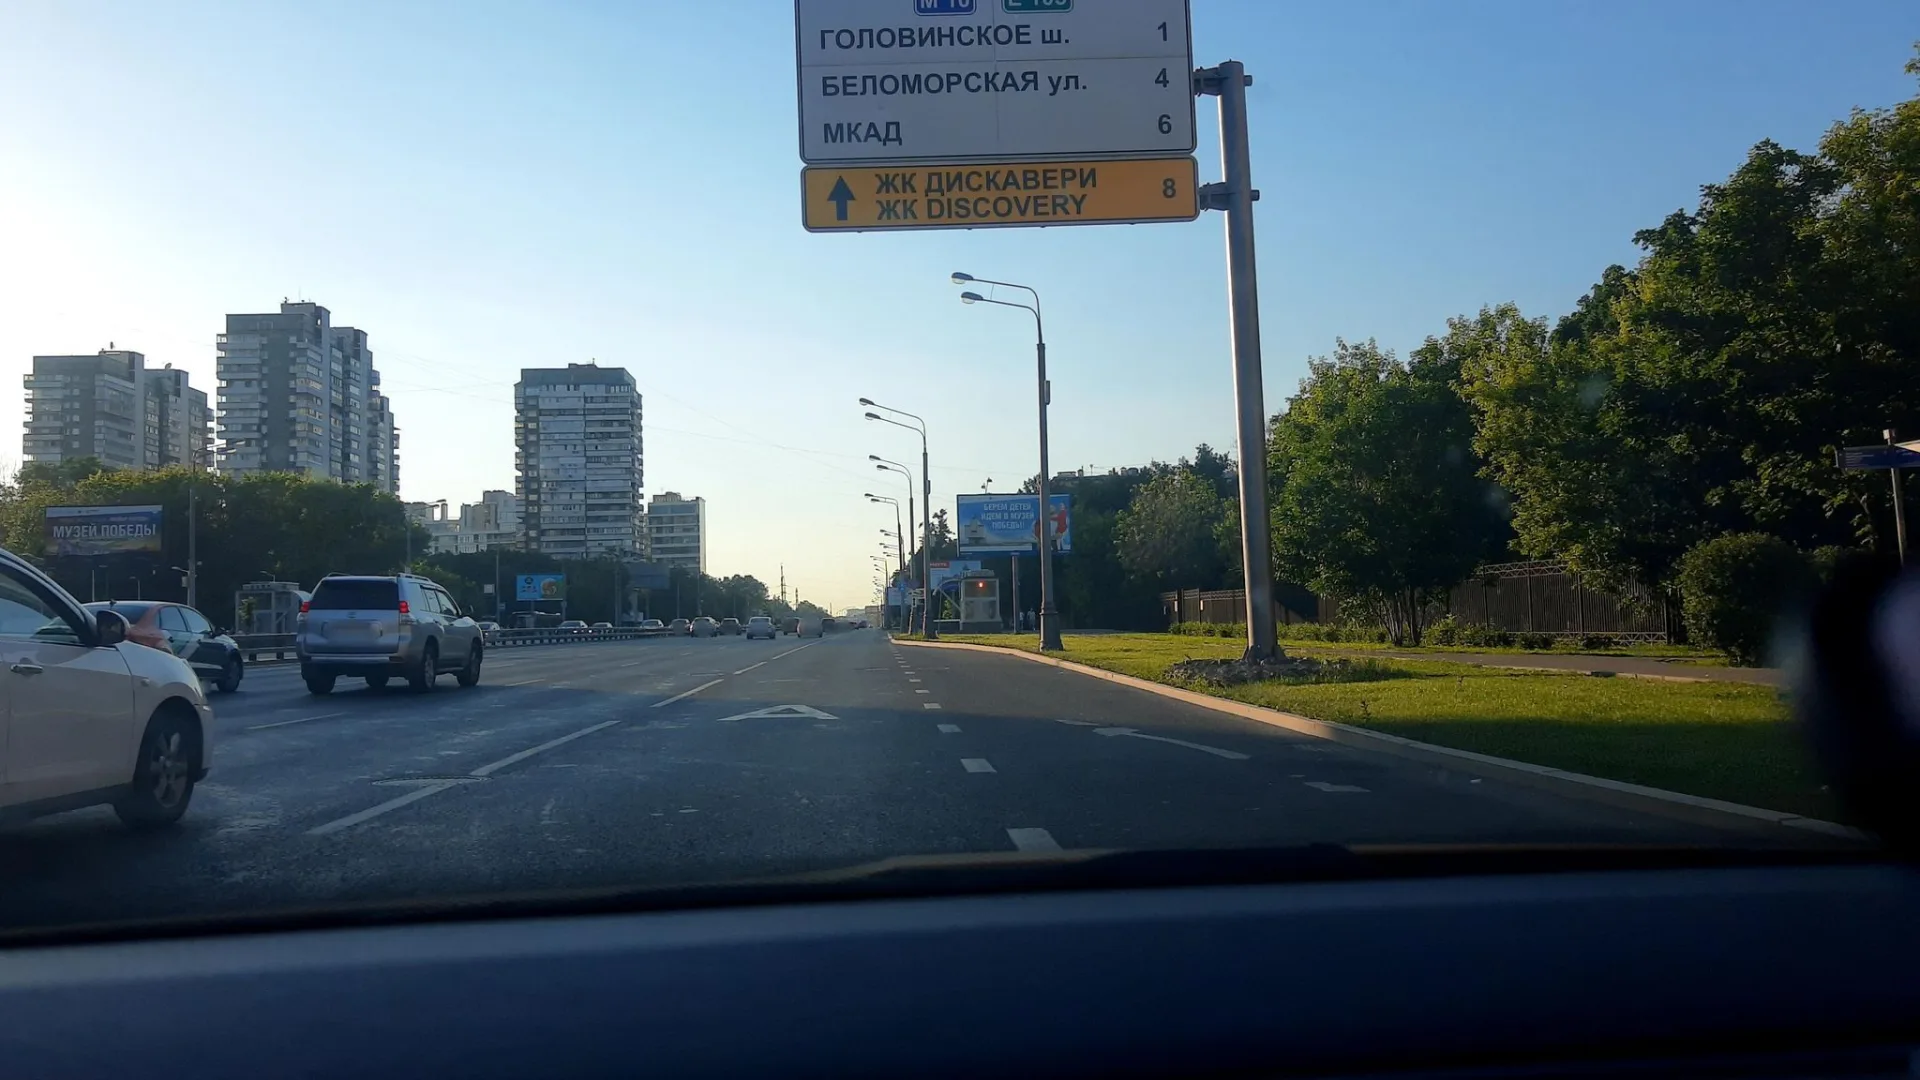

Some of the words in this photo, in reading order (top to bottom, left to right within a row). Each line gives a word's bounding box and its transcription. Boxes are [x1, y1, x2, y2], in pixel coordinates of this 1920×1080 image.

[820, 24, 1031, 50] ГОЛОВИНСКОЕ
[1041, 28, 1070, 44] ш.
[1157, 22, 1169, 42] 1
[821, 70, 1039, 97] БЕЛОМОРСКАЯ
[1048, 73, 1088, 96] ул.
[1155, 68, 1169, 89] 4
[823, 121, 903, 146] МКАД
[1157, 113, 1172, 135] 6
[875, 173, 917, 195] ЖК
[924, 168, 1097, 197] ДИСКАВЕРИ
[1162, 178, 1177, 199] 8
[876, 200, 918, 221] ЖК
[927, 194, 1087, 220] DISCOVERY
[53, 523, 97, 538] МУЗЕЙ
[101, 523, 157, 538] ПОБЕДЫ
